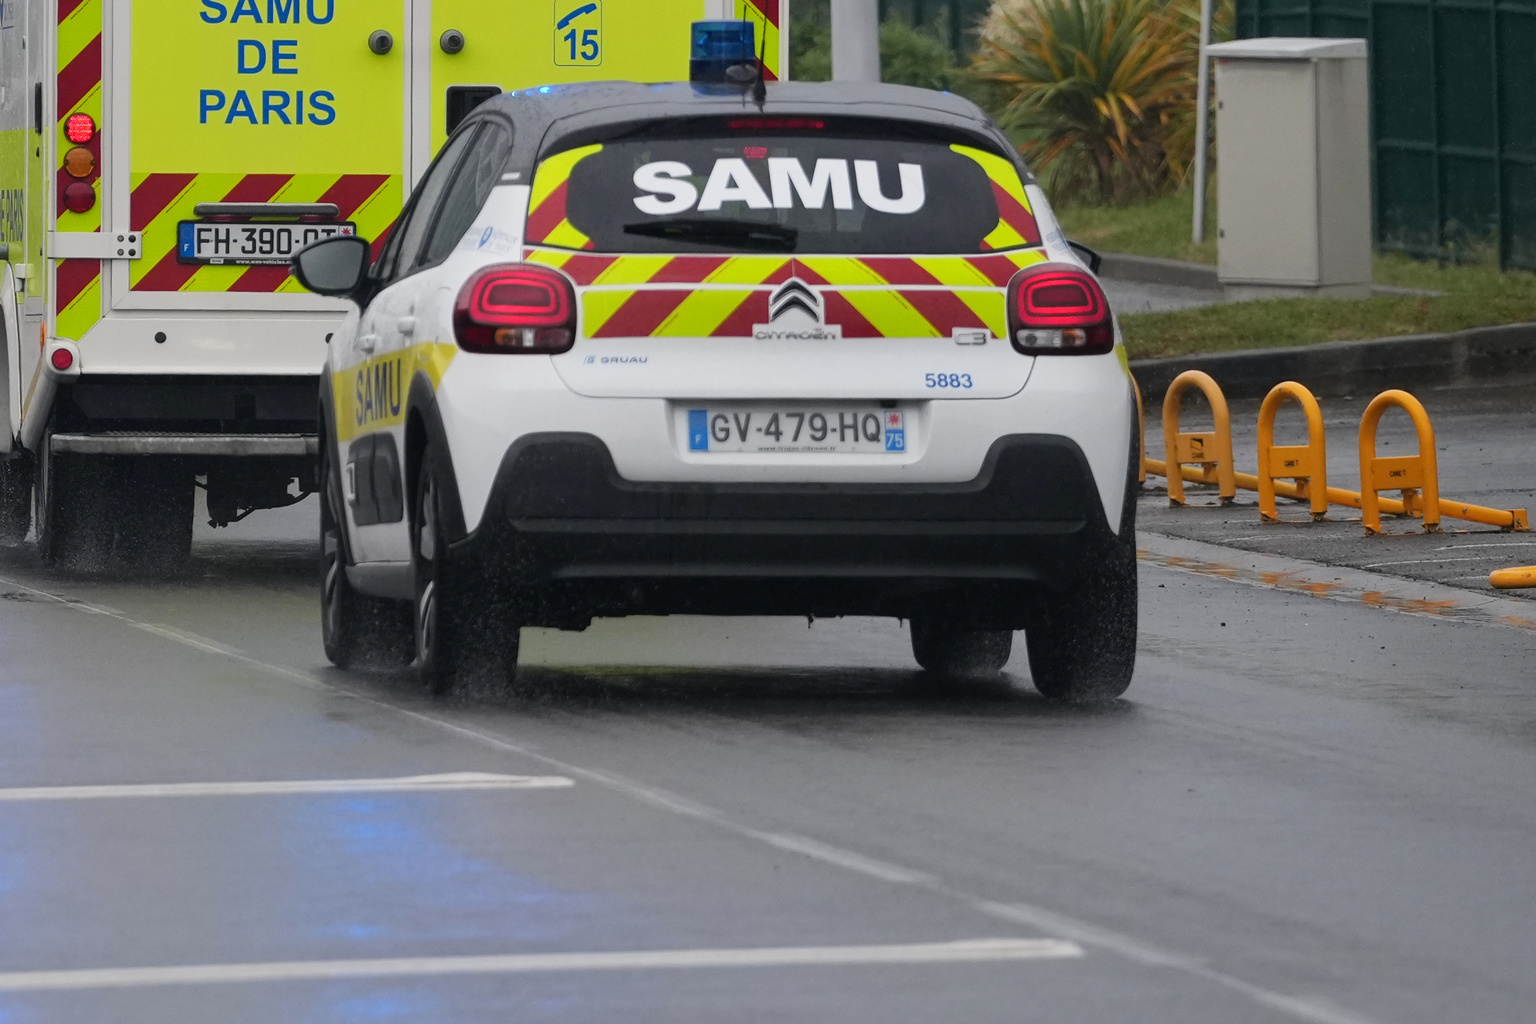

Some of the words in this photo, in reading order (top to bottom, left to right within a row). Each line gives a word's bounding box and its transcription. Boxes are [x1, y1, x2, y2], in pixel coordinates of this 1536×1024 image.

[237, 39, 298, 75] DE
[563, 28, 599, 61] 15
[199, 89, 336, 126] PARIS
[632, 157, 926, 215] SAMU
[6, 189, 24, 242] PARIS
[954, 332, 986, 346] C3
[355, 357, 402, 427] SAMU
[925, 373, 973, 389] 5883
[695, 434, 702, 444] F
[710, 412, 882, 443] GV-479-HQ
[886, 432, 904, 449] 75
